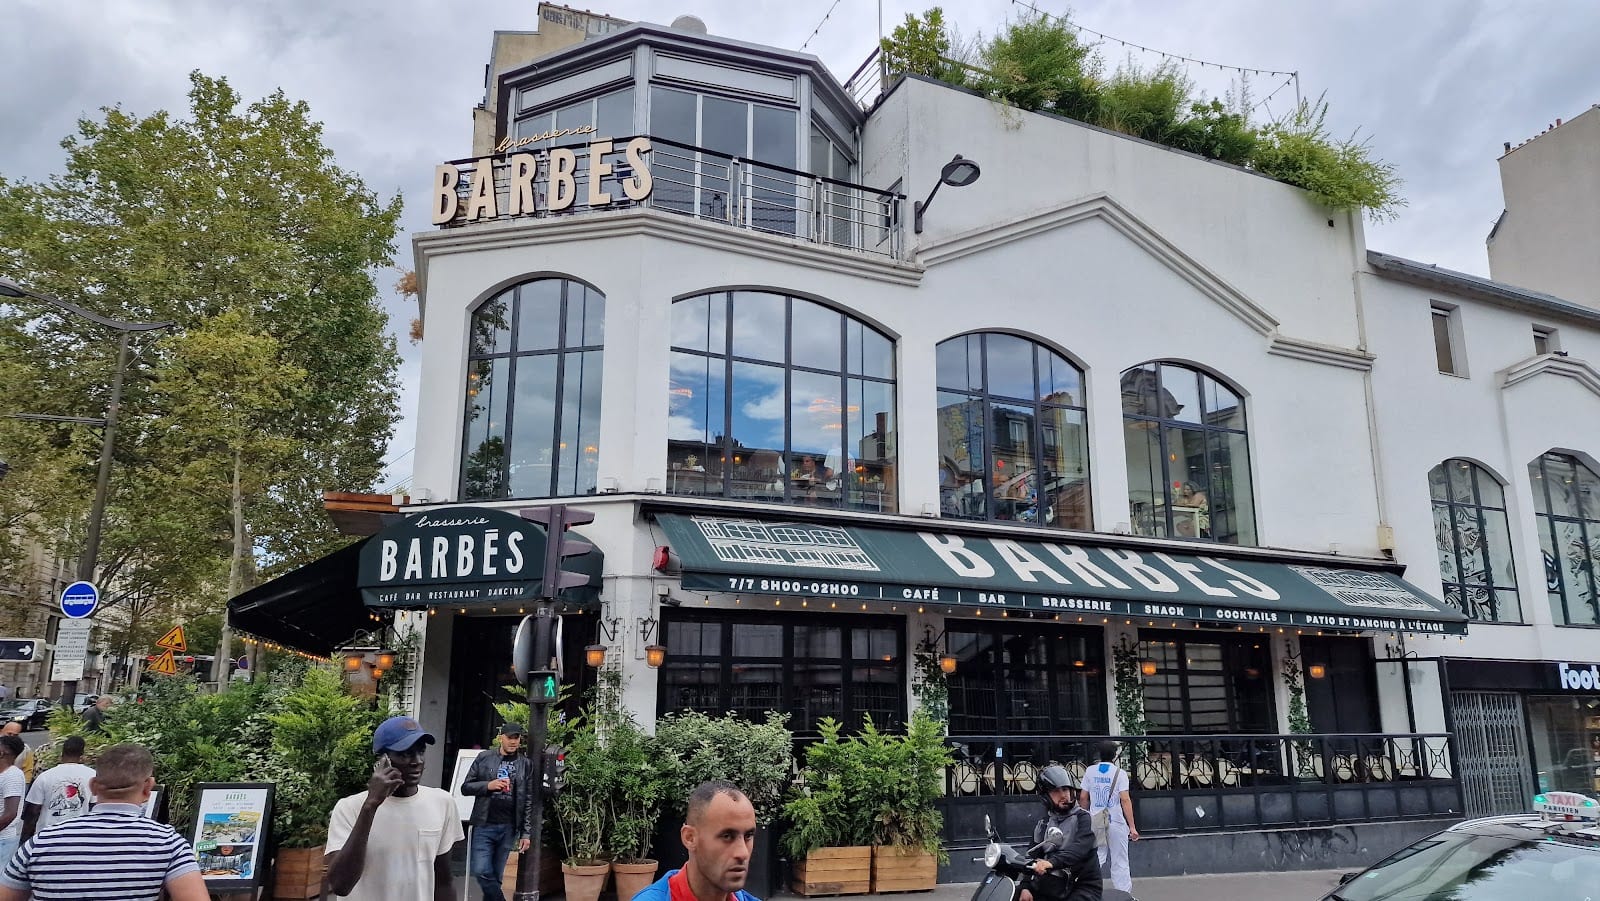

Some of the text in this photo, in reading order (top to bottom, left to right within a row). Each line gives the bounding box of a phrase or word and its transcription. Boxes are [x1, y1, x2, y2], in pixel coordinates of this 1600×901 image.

[496, 123, 599, 153] brasserie
[415, 515, 490, 528] brasserie
[729, 578, 859, 595] 7/7 8H00-02H00
[379, 587, 524, 602] CAFÉ BAR RESTAURANT DANCING
[902, 587, 939, 600] CAFÉ
[978, 593, 1006, 604] BAR
[1042, 597, 1112, 611] BRASSERIE
[1144, 605, 1185, 616] SNACK
[1216, 609, 1278, 621] COCKTAILS
[1306, 615, 1444, 631] PATIO ET DANCING À L'ÉTAGE
[1550, 794, 1576, 806] TAXI
[1543, 804, 1579, 815] PARISIEN
